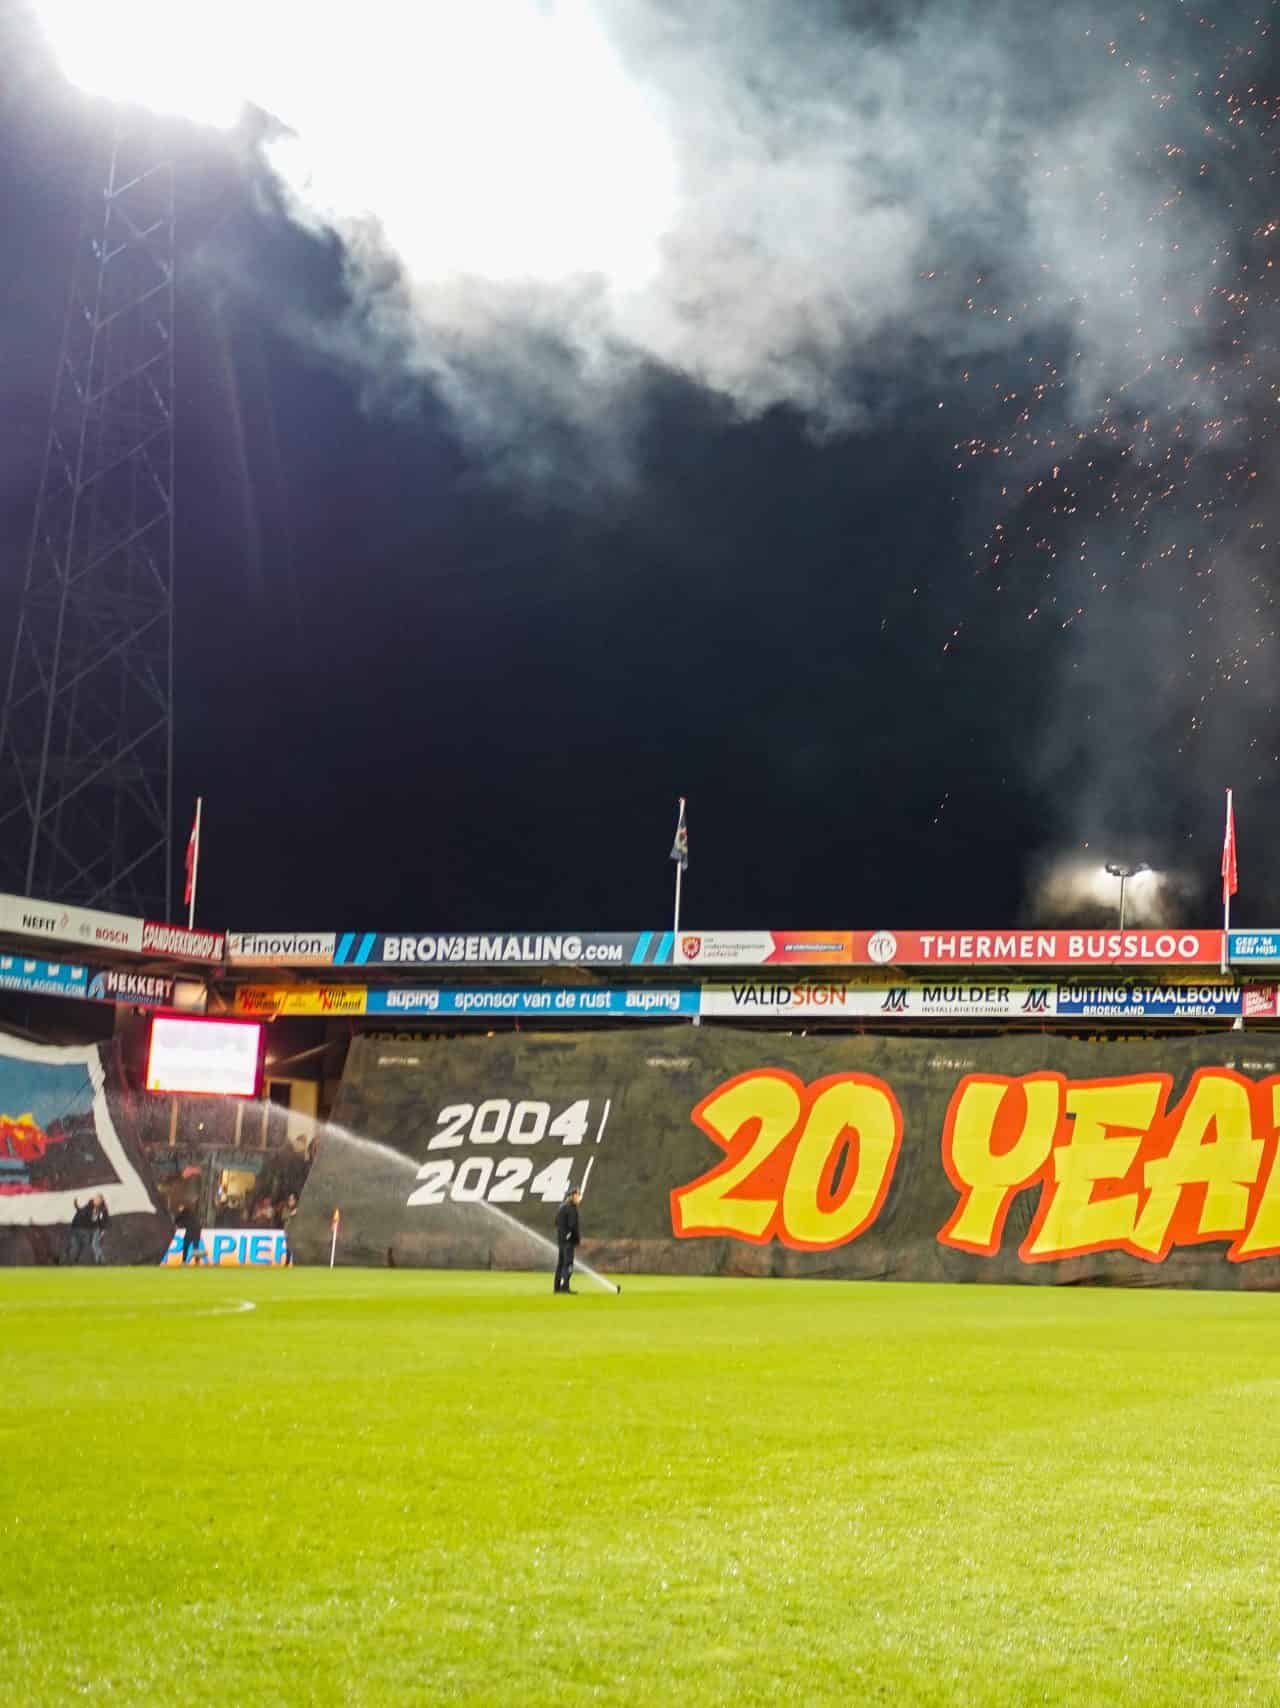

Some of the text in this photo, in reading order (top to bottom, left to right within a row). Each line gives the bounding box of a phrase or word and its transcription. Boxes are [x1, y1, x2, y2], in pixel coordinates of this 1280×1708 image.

[95, 927, 129, 944] BOSCH
[920, 936, 1056, 958] THERMEN
[1068, 935, 1200, 958] BUSSLOO
[107, 973, 173, 996] HEKKERT
[731, 984, 847, 1006] VALIDSIGN
[922, 987, 1010, 1003] MULDER
[387, 990, 439, 1009] auping
[454, 990, 611, 1012] sponsor van de rust
[625, 990, 680, 1010] auping
[1059, 988, 1127, 1003] BUITING
[1131, 987, 1239, 1004] STAALBOUW
[1083, 1005, 1144, 1016] BROEKLAND
[1174, 1005, 1216, 1016] ALMELO
[427, 1099, 590, 1150] 2004
[671, 1068, 904, 1252] 20
[407, 1157, 574, 1207] 2024
